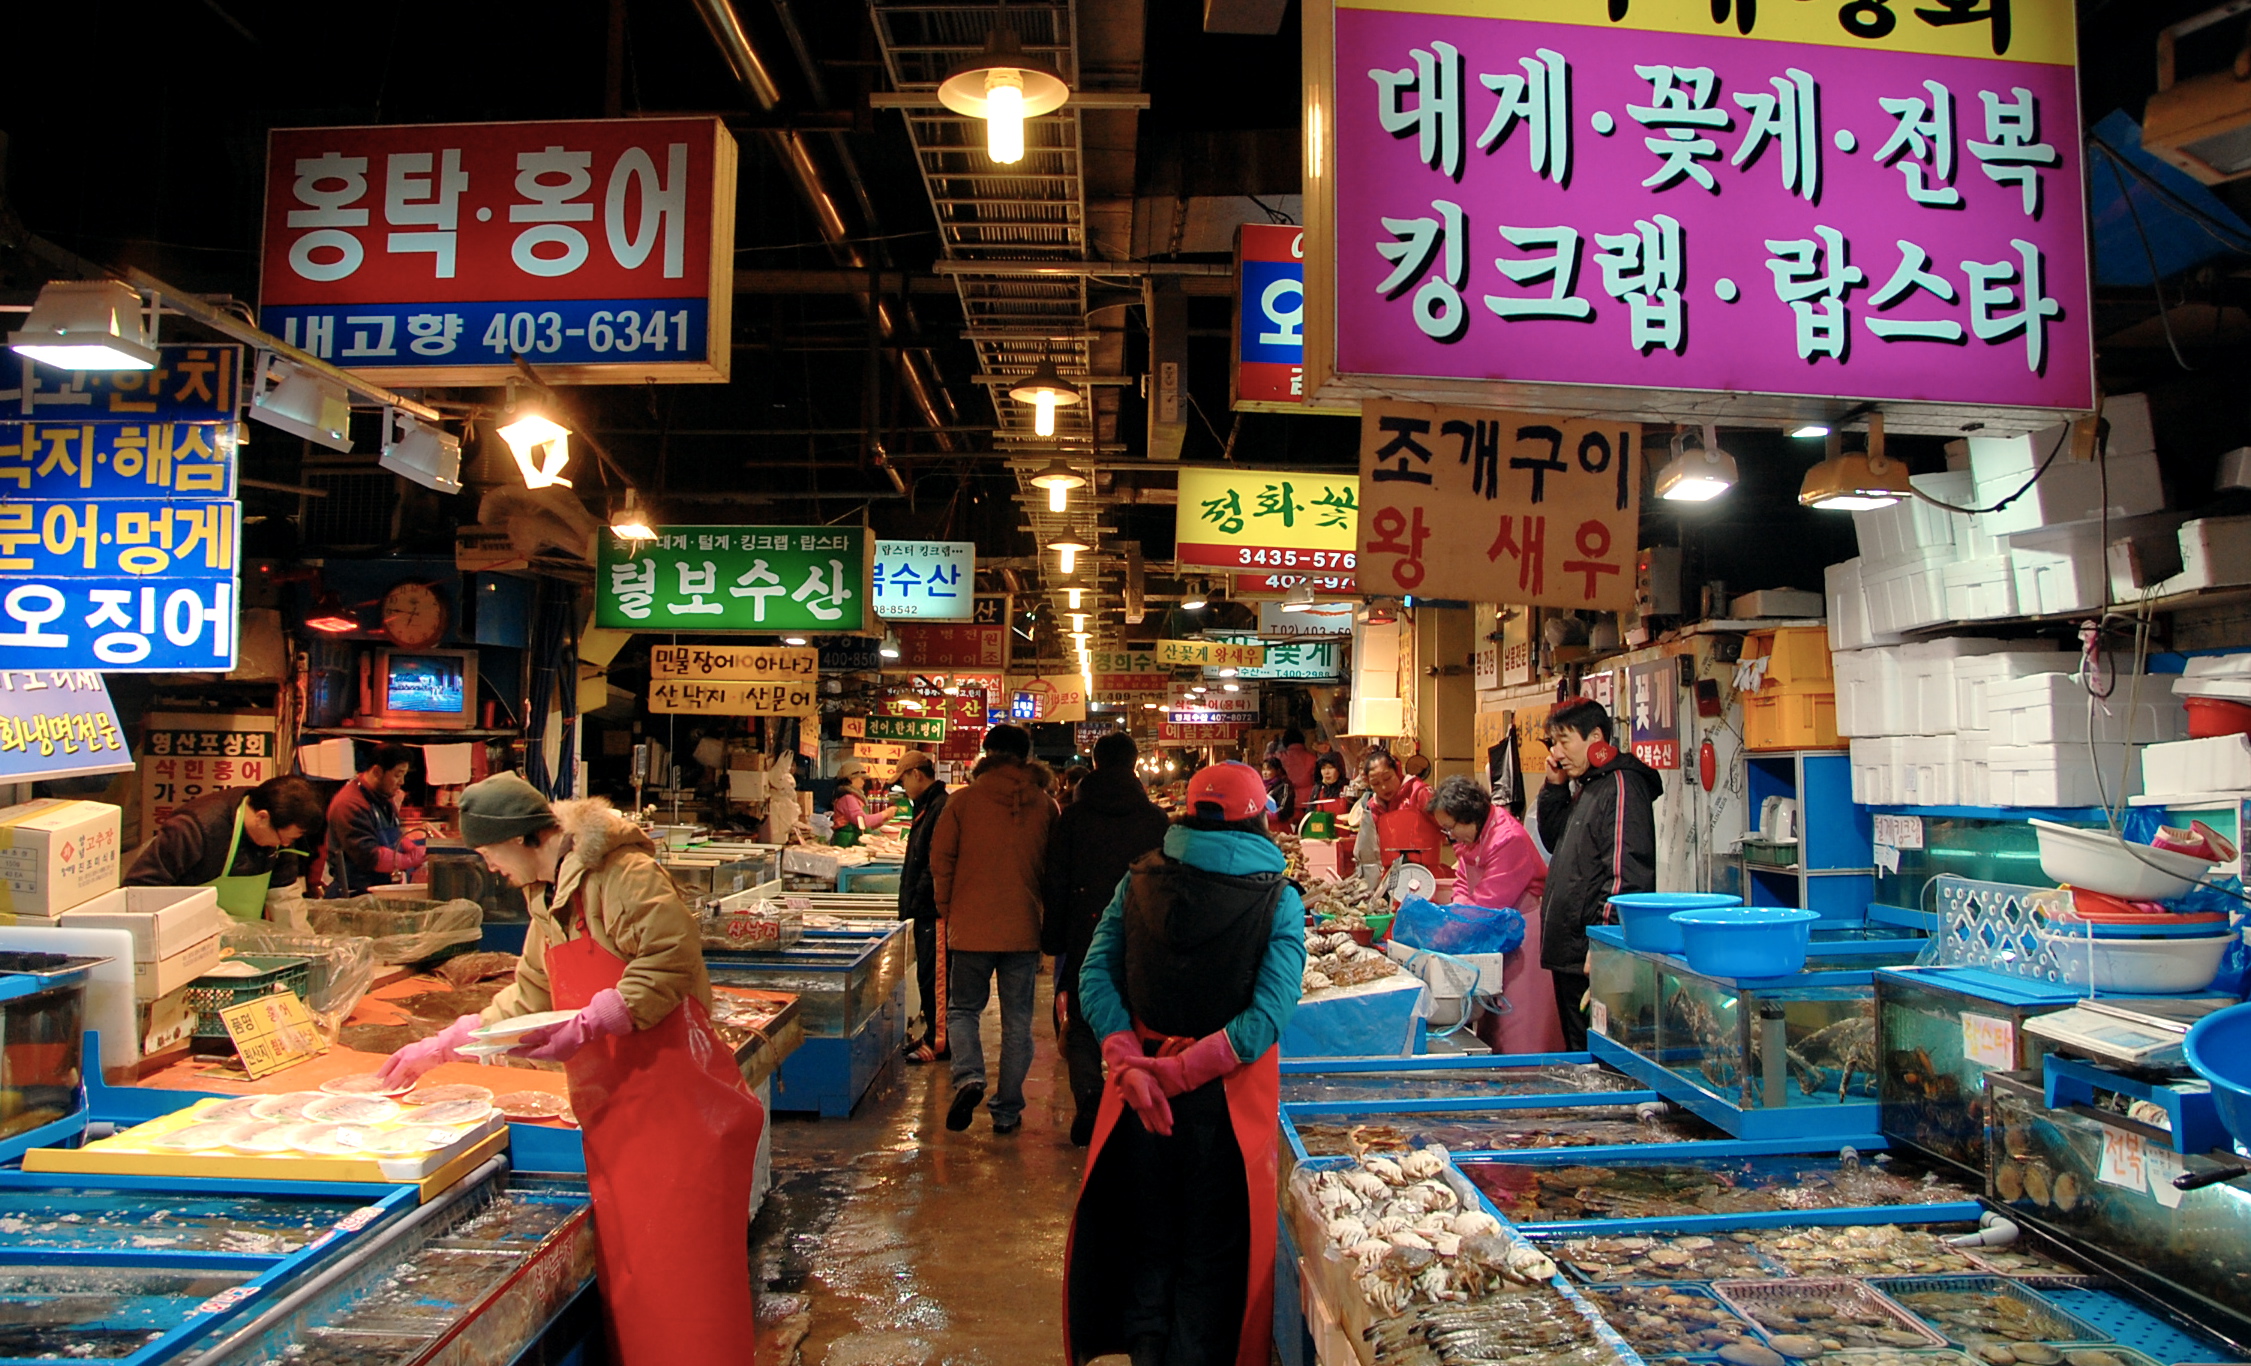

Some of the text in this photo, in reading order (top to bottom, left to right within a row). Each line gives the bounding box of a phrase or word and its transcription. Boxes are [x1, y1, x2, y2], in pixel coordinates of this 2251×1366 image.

[1367, 40, 2060, 219] 대게·꽃게·전복
[287, 142, 688, 283] 홍탁·홍어
[482, 309, 689, 355] 403-6341
[1372, 415, 1630, 511] 조개구이
[611, 558, 852, 622] 털보수산
[0, 583, 231, 664] 오징어
[656, 647, 814, 675] 민물장어 아나고
[1163, 643, 1259, 665] 산꽃게 왕새우
[655, 685, 810, 713] 산낙지 산문어
[1635, 668, 1672, 732] 꽃게
[1210, 713, 1252, 722] 407-8072
[152, 732, 266, 757] 영산포상회
[86, 827, 115, 851] 고추장
[728, 920, 779, 940] 산낙지
[230, 1012, 255, 1035] 품명
[243, 1042, 271, 1066] 원산지
[2103, 1130, 2142, 1185] 전복
